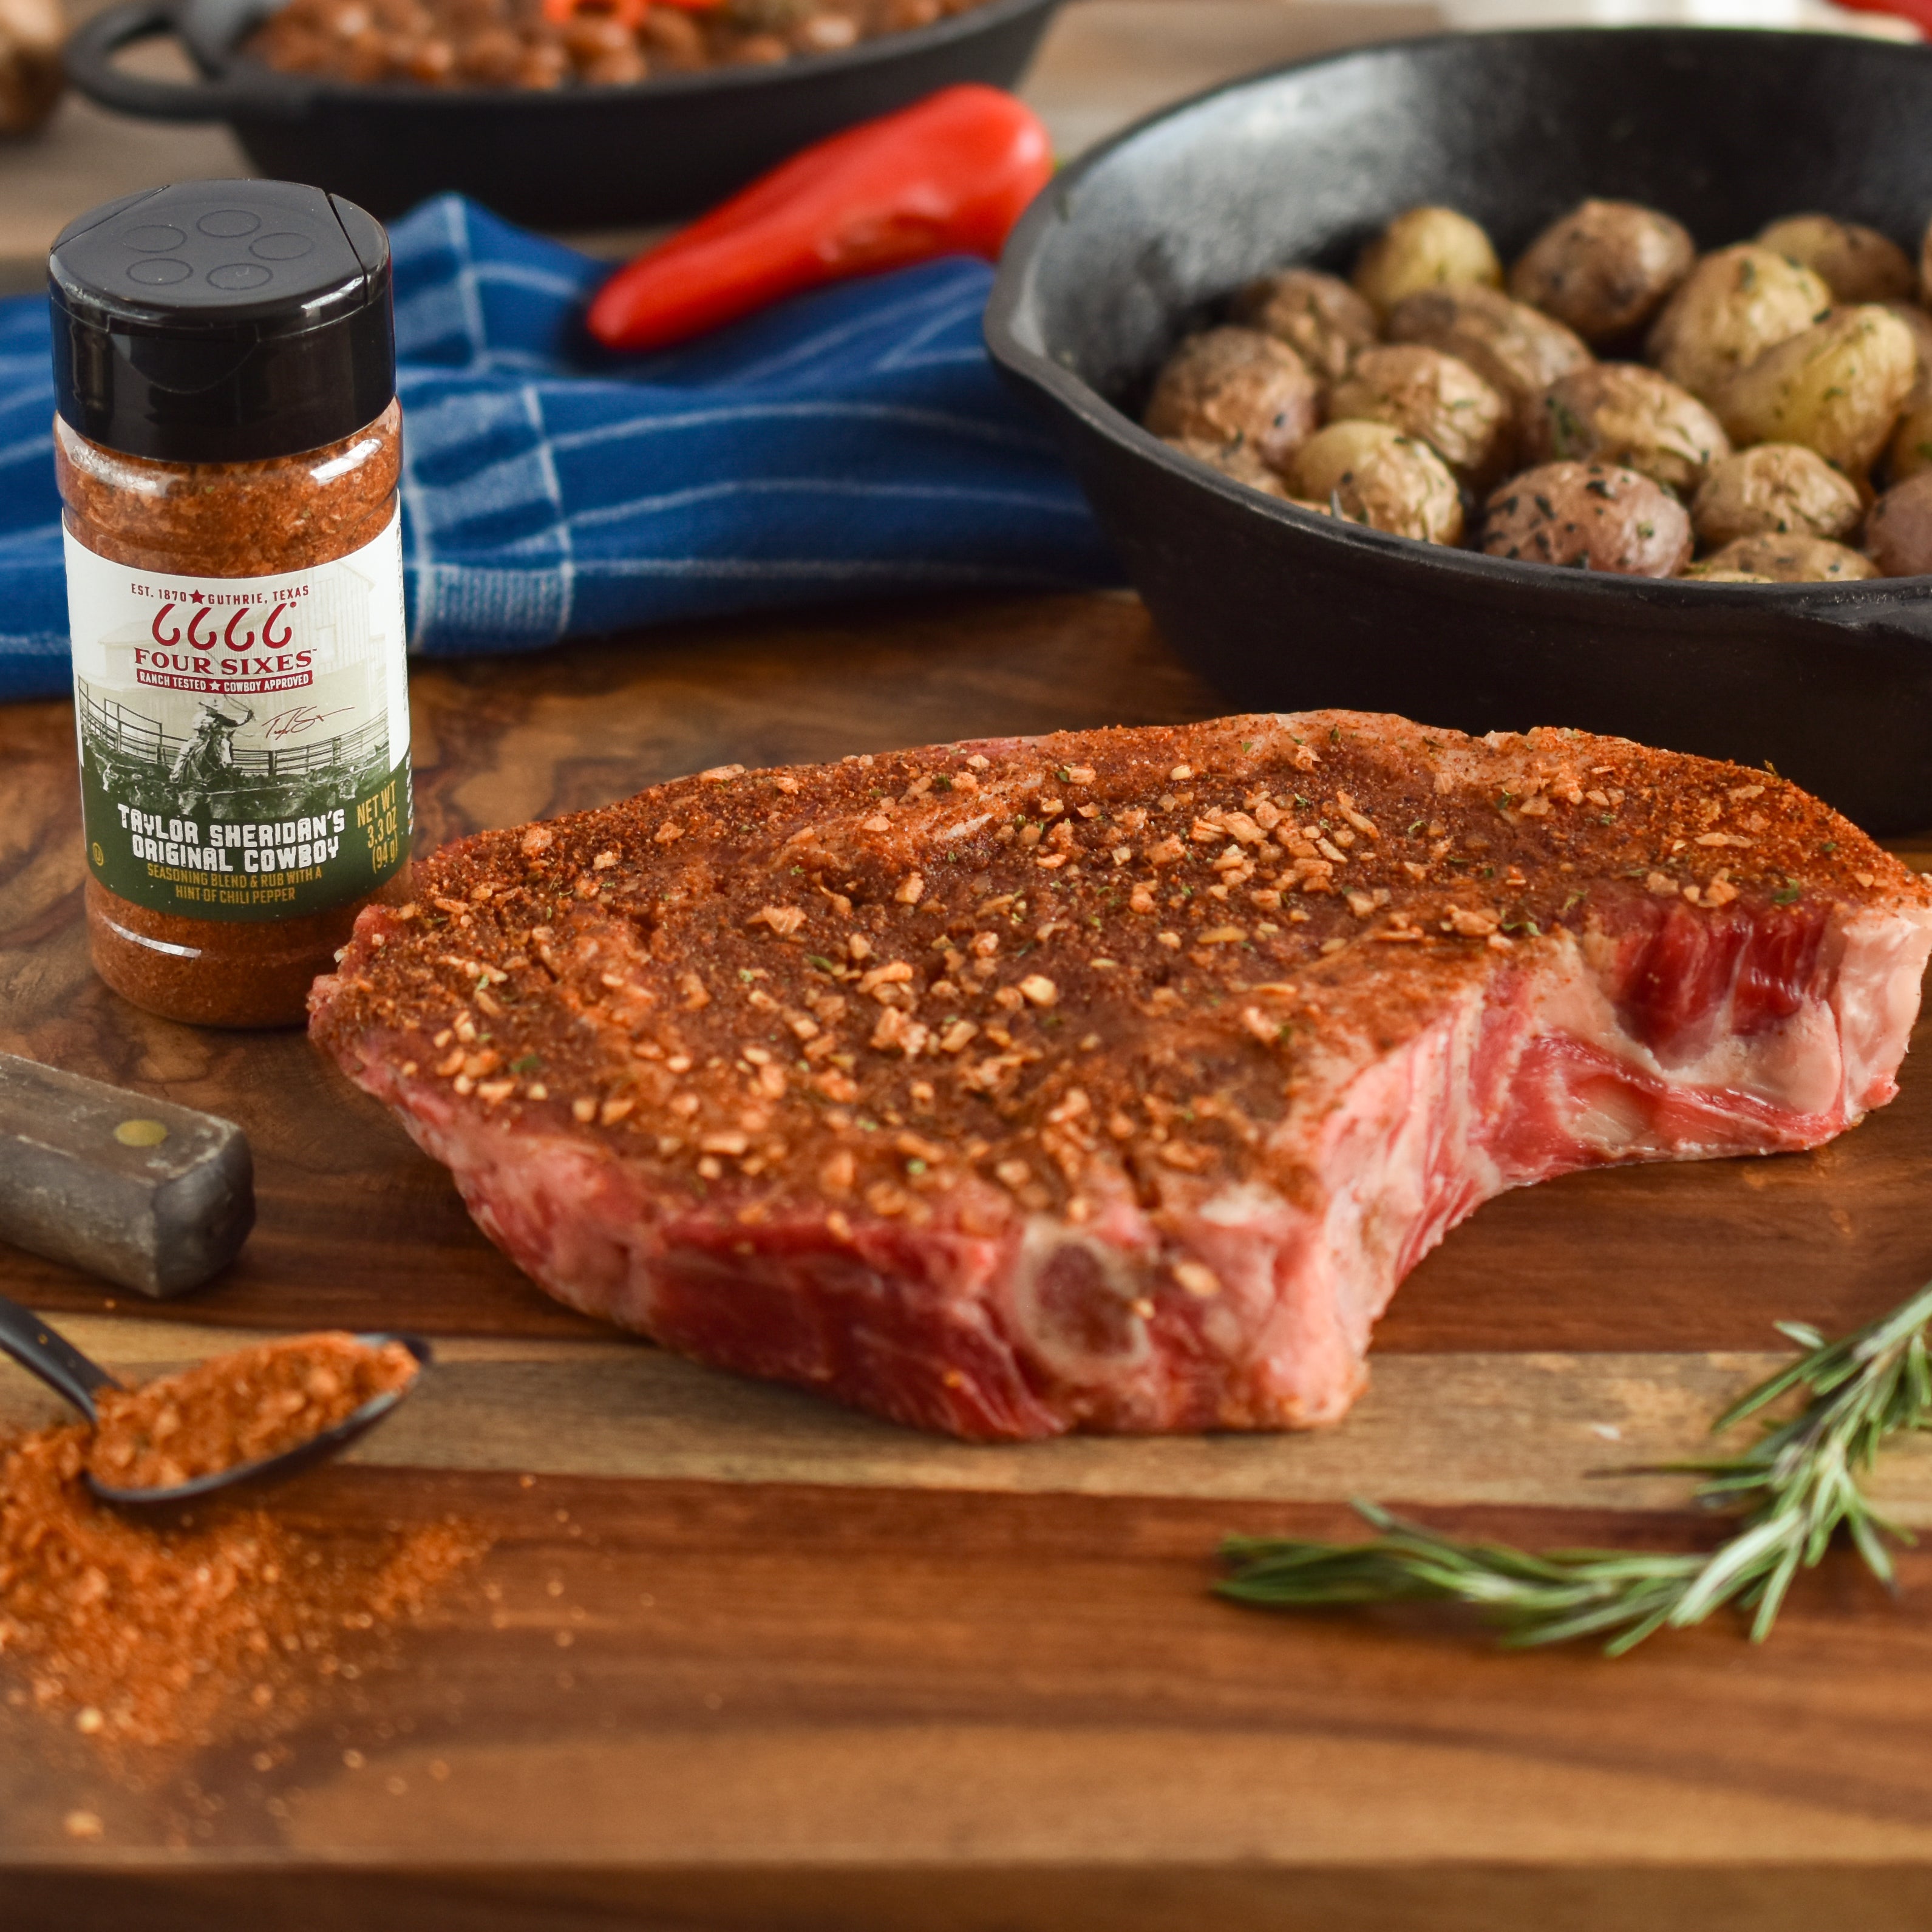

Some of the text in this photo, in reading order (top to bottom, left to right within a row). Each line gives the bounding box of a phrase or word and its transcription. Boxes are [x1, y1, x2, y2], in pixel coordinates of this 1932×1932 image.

[131, 583, 308, 605] EST. 1870 GUTHRIE, TEXAS
[134, 647, 214, 675] FOUR
[140, 671, 309, 692] RANCH TESTED COWBOY APPROVED
[357, 780, 396, 828] NET WT
[118, 803, 345, 848] TAYLOR SHERIDAN'S
[367, 806, 397, 848] 3.3 OZ
[132, 834, 339, 872] ORIGINAL COWBOY
[372, 842, 387, 874] (94
[147, 863, 322, 888] SEASONING BLEND & RUB WITH A
[175, 885, 296, 904] HINT OF CHILI PEPPER
